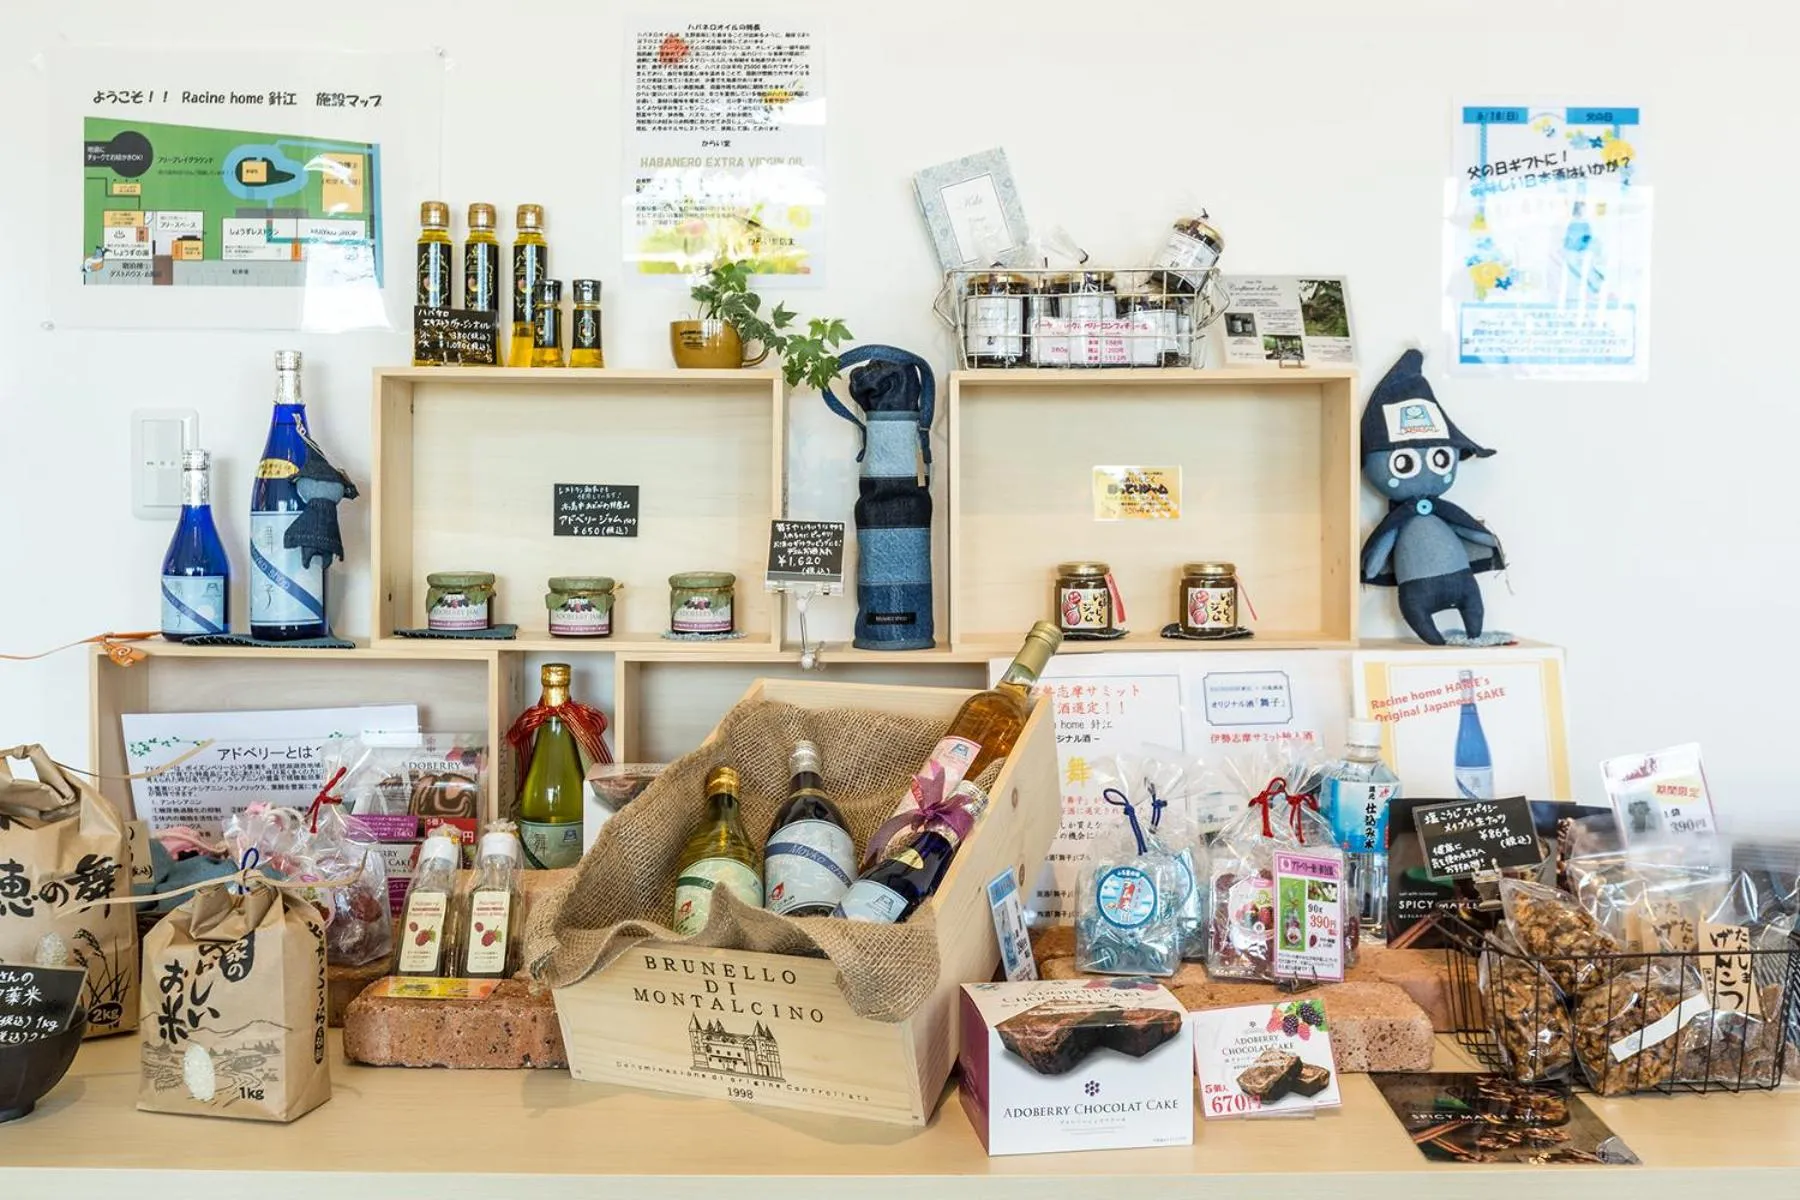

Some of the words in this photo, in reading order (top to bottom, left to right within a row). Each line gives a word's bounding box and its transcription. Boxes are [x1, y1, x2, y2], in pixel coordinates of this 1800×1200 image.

[93, 90, 168, 104] ようこそ！！
[182, 90, 226, 104] Racine
[230, 91, 264, 104] home
[268, 91, 297, 106] 針江
[316, 91, 382, 107] 施設マップ
[640, 157, 702, 168] HABANERO
[705, 157, 744, 168] EXTRA
[1371, 695, 1409, 710] Racine
[1410, 687, 1442, 702] home
[1374, 707, 1421, 724] Original
[1423, 697, 1474, 714] Japanese
[1475, 687, 1506, 702] SAKE
[1060, 719, 1085, 729] home
[1364, 802, 1377, 850] 仕込み水
[1500, 834, 1532, 849] (税込)
[1398, 900, 1435, 910] SPICY
[644, 954, 797, 985] BRUNELLO
[705, 978, 737, 996] DI
[92, 1004, 121, 1022] 2kg
[633, 986, 825, 1024] MONTALCINO
[36, 1015, 59, 1032] 1kg
[239, 1086, 265, 1101] 1kg
[726, 1086, 755, 1100] 1998
[1002, 1105, 1070, 1119] ADOBERRY
[1073, 1101, 1143, 1117] CHOCOLAT
[1145, 1098, 1179, 1112] CAKE
[1411, 1113, 1453, 1121] SPICY
